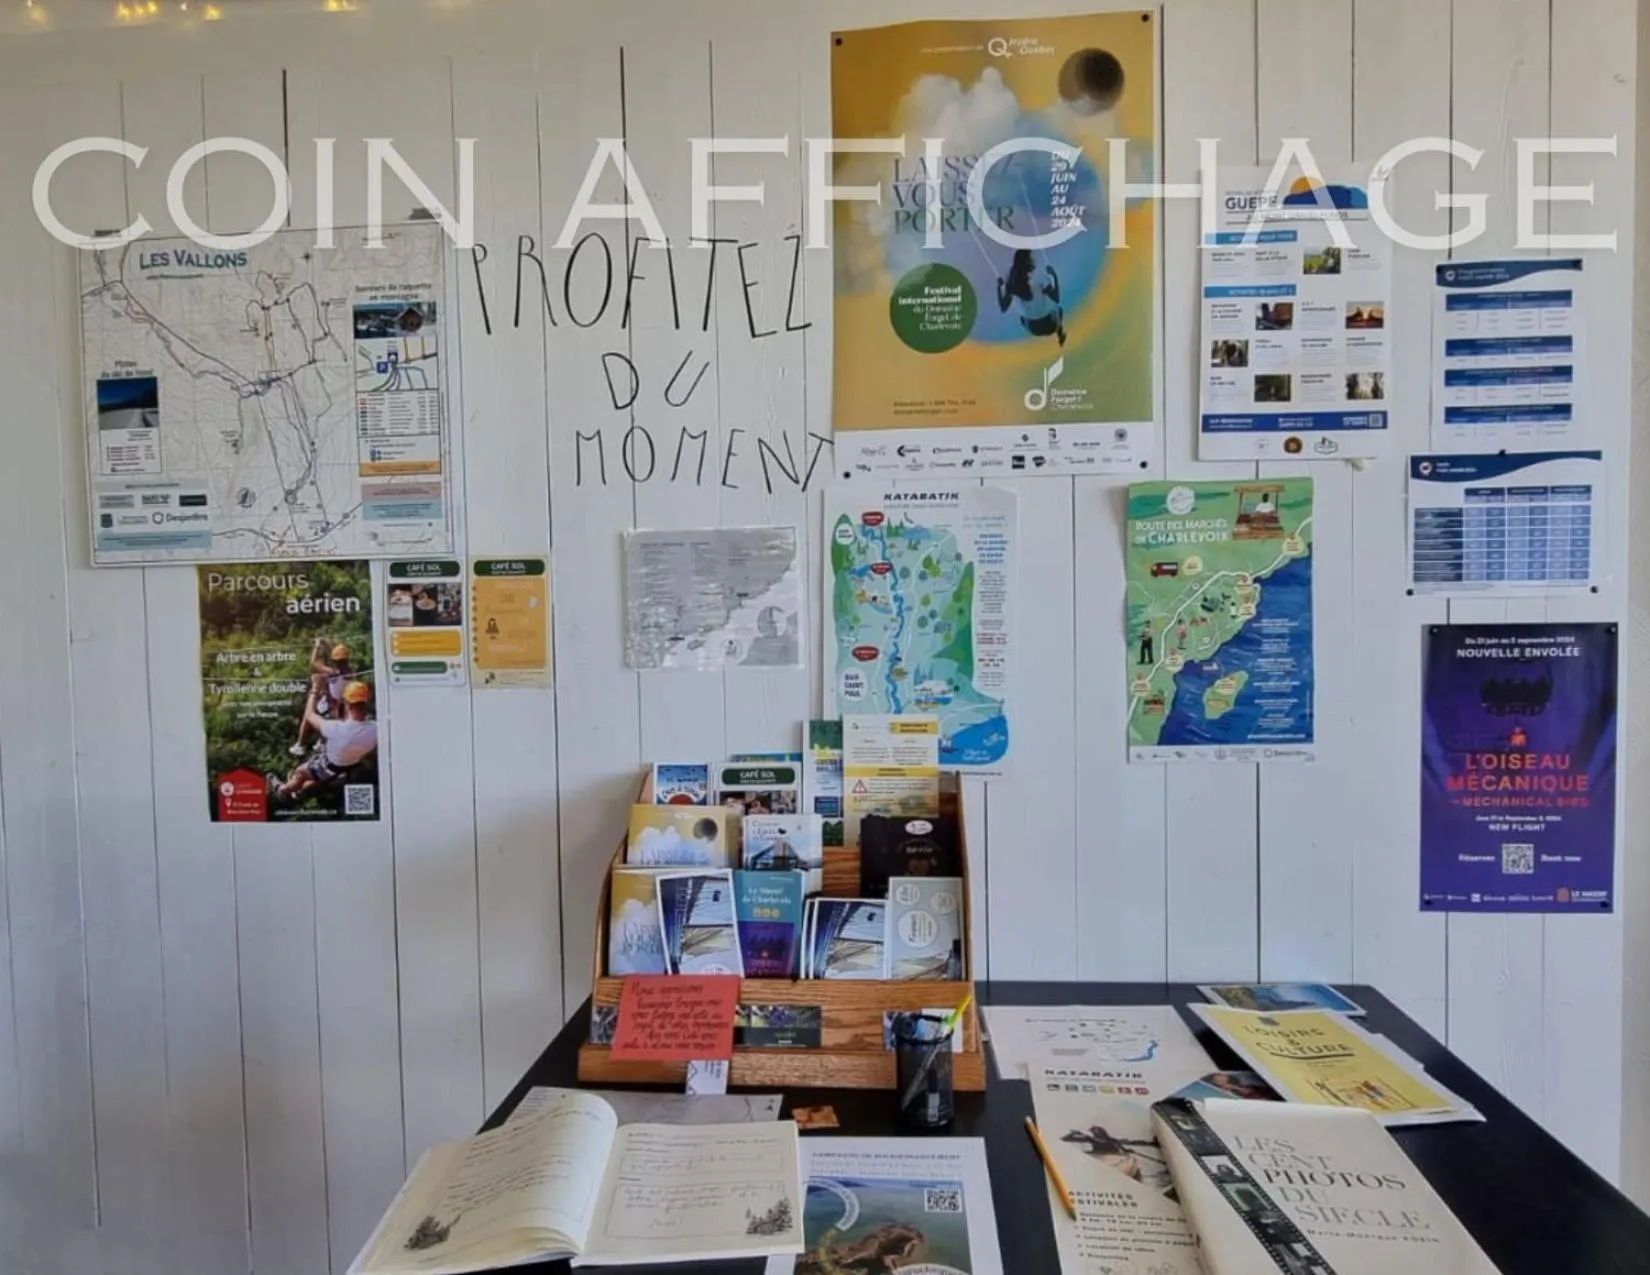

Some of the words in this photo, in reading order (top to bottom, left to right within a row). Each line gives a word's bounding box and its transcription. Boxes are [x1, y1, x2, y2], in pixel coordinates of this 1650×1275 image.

[1050, 172, 1078, 185] JUIN
[1050, 183, 1069, 195] AU
[893, 206, 1015, 234] PORTR
[139, 252, 170, 271] LES
[172, 248, 248, 269] VALLONS
[471, 232, 813, 338] PROFITEZ
[602, 350, 710, 410] DU
[575, 426, 835, 495] MOMENT
[883, 491, 960, 501] KATABATIK
[1148, 530, 1229, 544] CHARLEVOIX
[406, 563, 426, 572] CAFÉ
[208, 572, 310, 592] Parcours
[285, 592, 361, 614] aérien
[216, 653, 249, 664] Arbre
[251, 654, 264, 663] en
[266, 652, 297, 662] arbre
[1456, 647, 1521, 659] NOUVELLE
[1524, 645, 1581, 658] ENVOLÉE
[209, 683, 267, 695] Tyrolienne
[268, 681, 307, 693] double
[1465, 753, 1571, 770] L'OISEAU
[739, 768, 760, 779] CAFÉ
[1445, 770, 1590, 793] MÉCANIQUE
[1463, 797, 1553, 807] MECHANICAL
[1488, 823, 1510, 832] NEW
[1512, 822, 1546, 832] FLIGHT
[1242, 1025, 1325, 1038] LOISIRS
[1255, 1042, 1355, 1056] CULTURE
[1044, 1068, 1143, 1079] KATABATIK
[1234, 1135, 1296, 1153] LES
[1249, 1152, 1333, 1171] CENT
[1262, 1167, 1407, 1190] PHOTOS
[1278, 1186, 1331, 1205] DU
